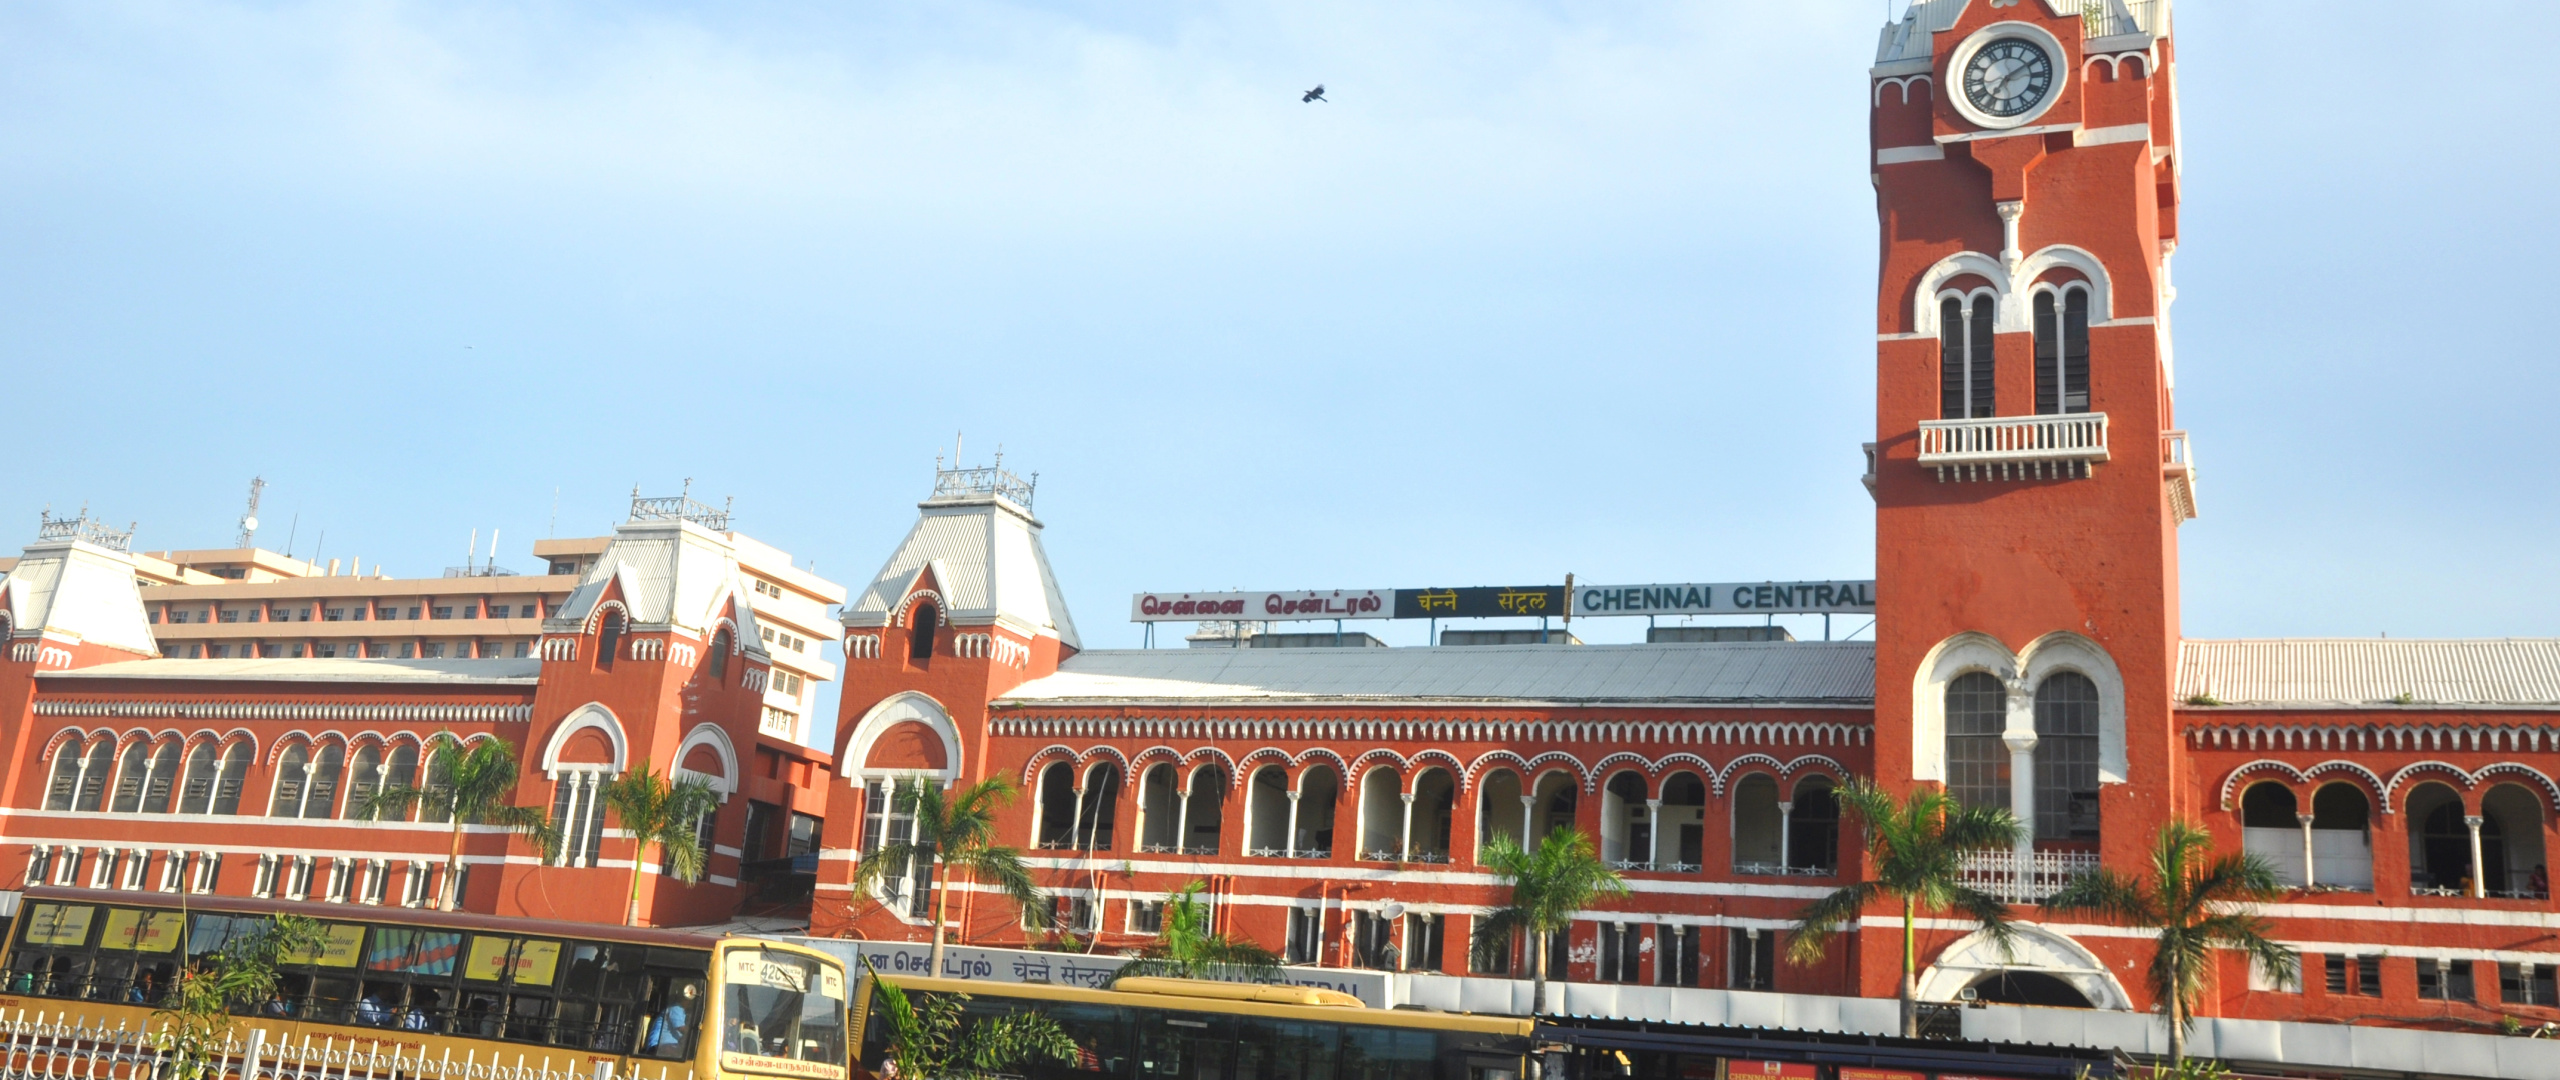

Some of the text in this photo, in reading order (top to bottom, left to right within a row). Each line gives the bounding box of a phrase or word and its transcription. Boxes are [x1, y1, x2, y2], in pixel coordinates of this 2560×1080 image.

[1141, 590, 1381, 616] சென்னை சென்ட்ரல்
[1498, 586, 1548, 614] सेंट्रल
[1582, 584, 1875, 611] CHENNAI CENTRAL
[738, 962, 755, 972] MTC
[825, 976, 837, 987] MTC
